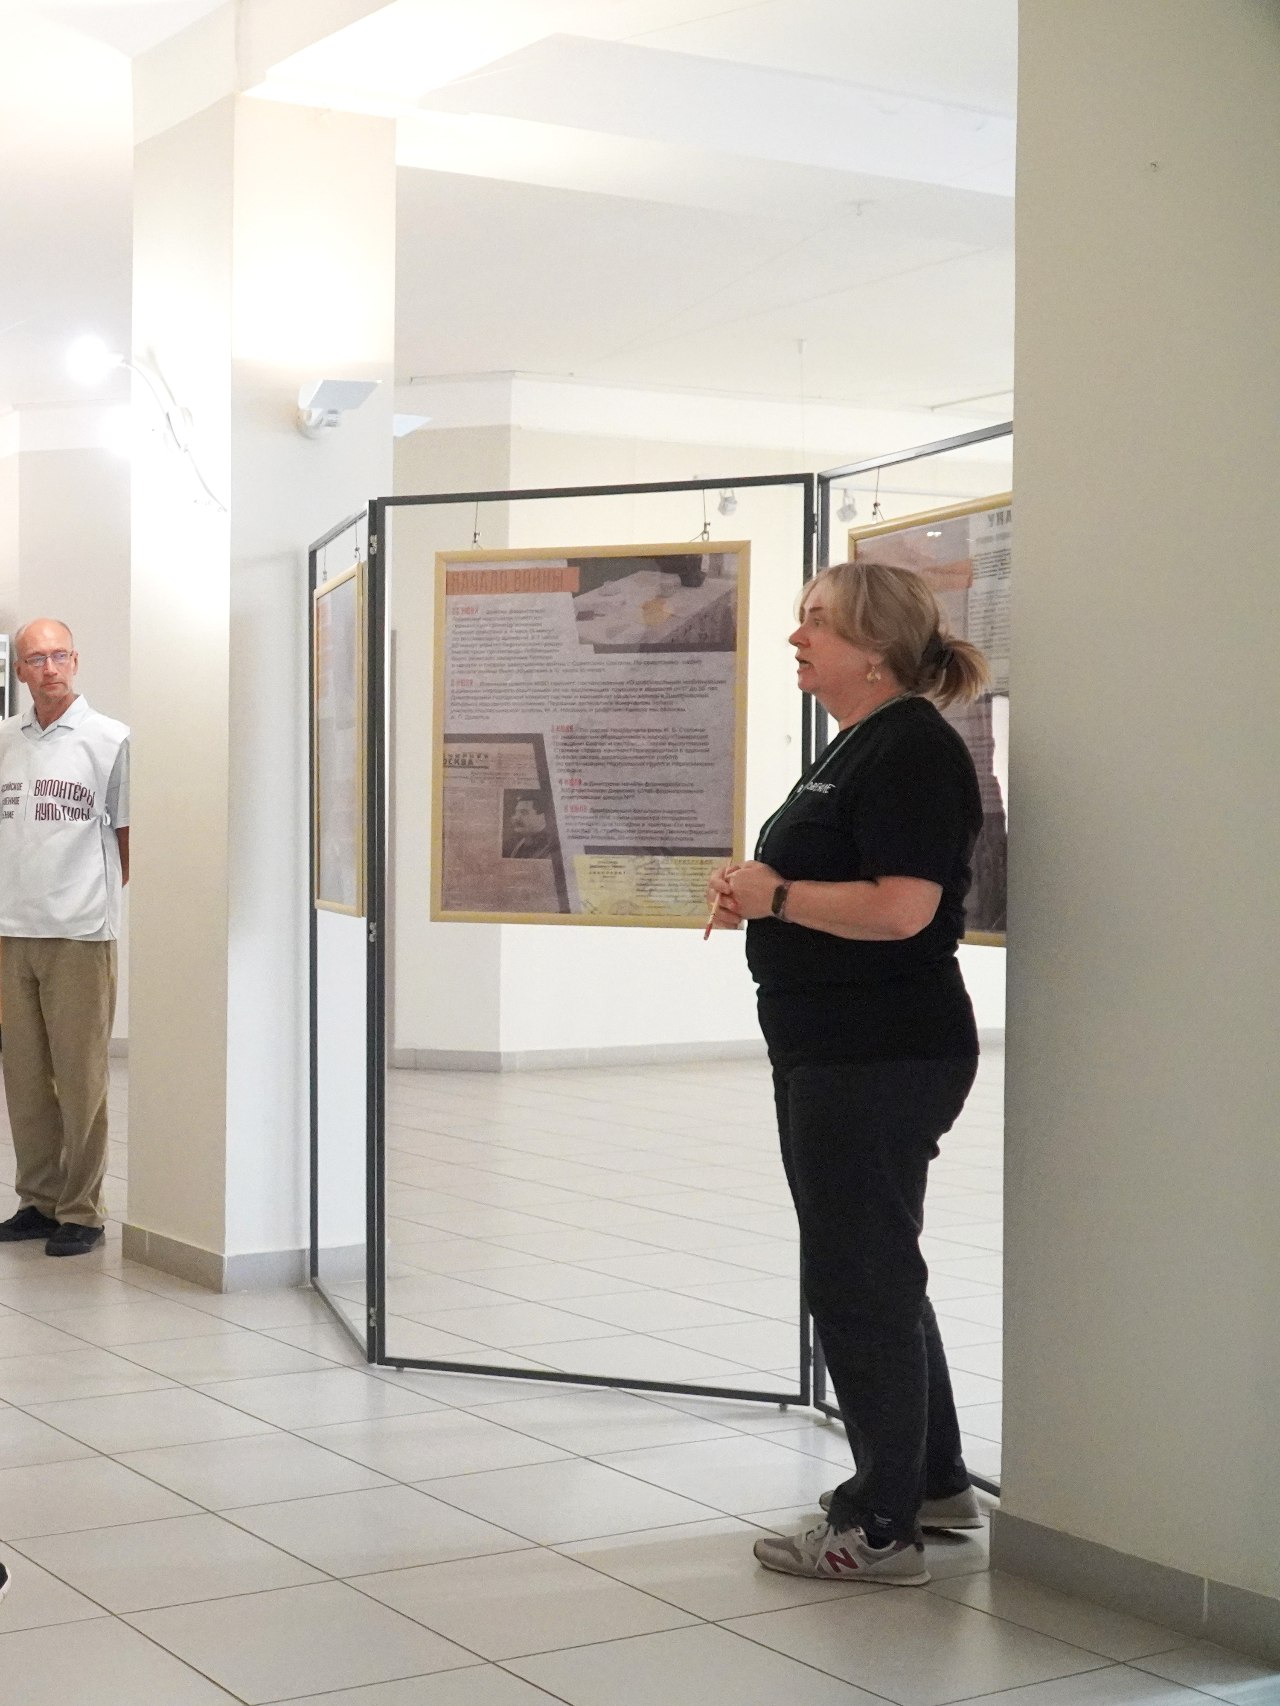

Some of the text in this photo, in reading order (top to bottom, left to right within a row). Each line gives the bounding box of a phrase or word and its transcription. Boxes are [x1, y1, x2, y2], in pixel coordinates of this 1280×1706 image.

[443, 758, 474, 766] ОСКВА
[33, 779, 96, 807] ВОЛОНТЁРЫ
[35, 803, 92, 822] КУЛЬТУРЫ
[824, 1547, 859, 1573] N
